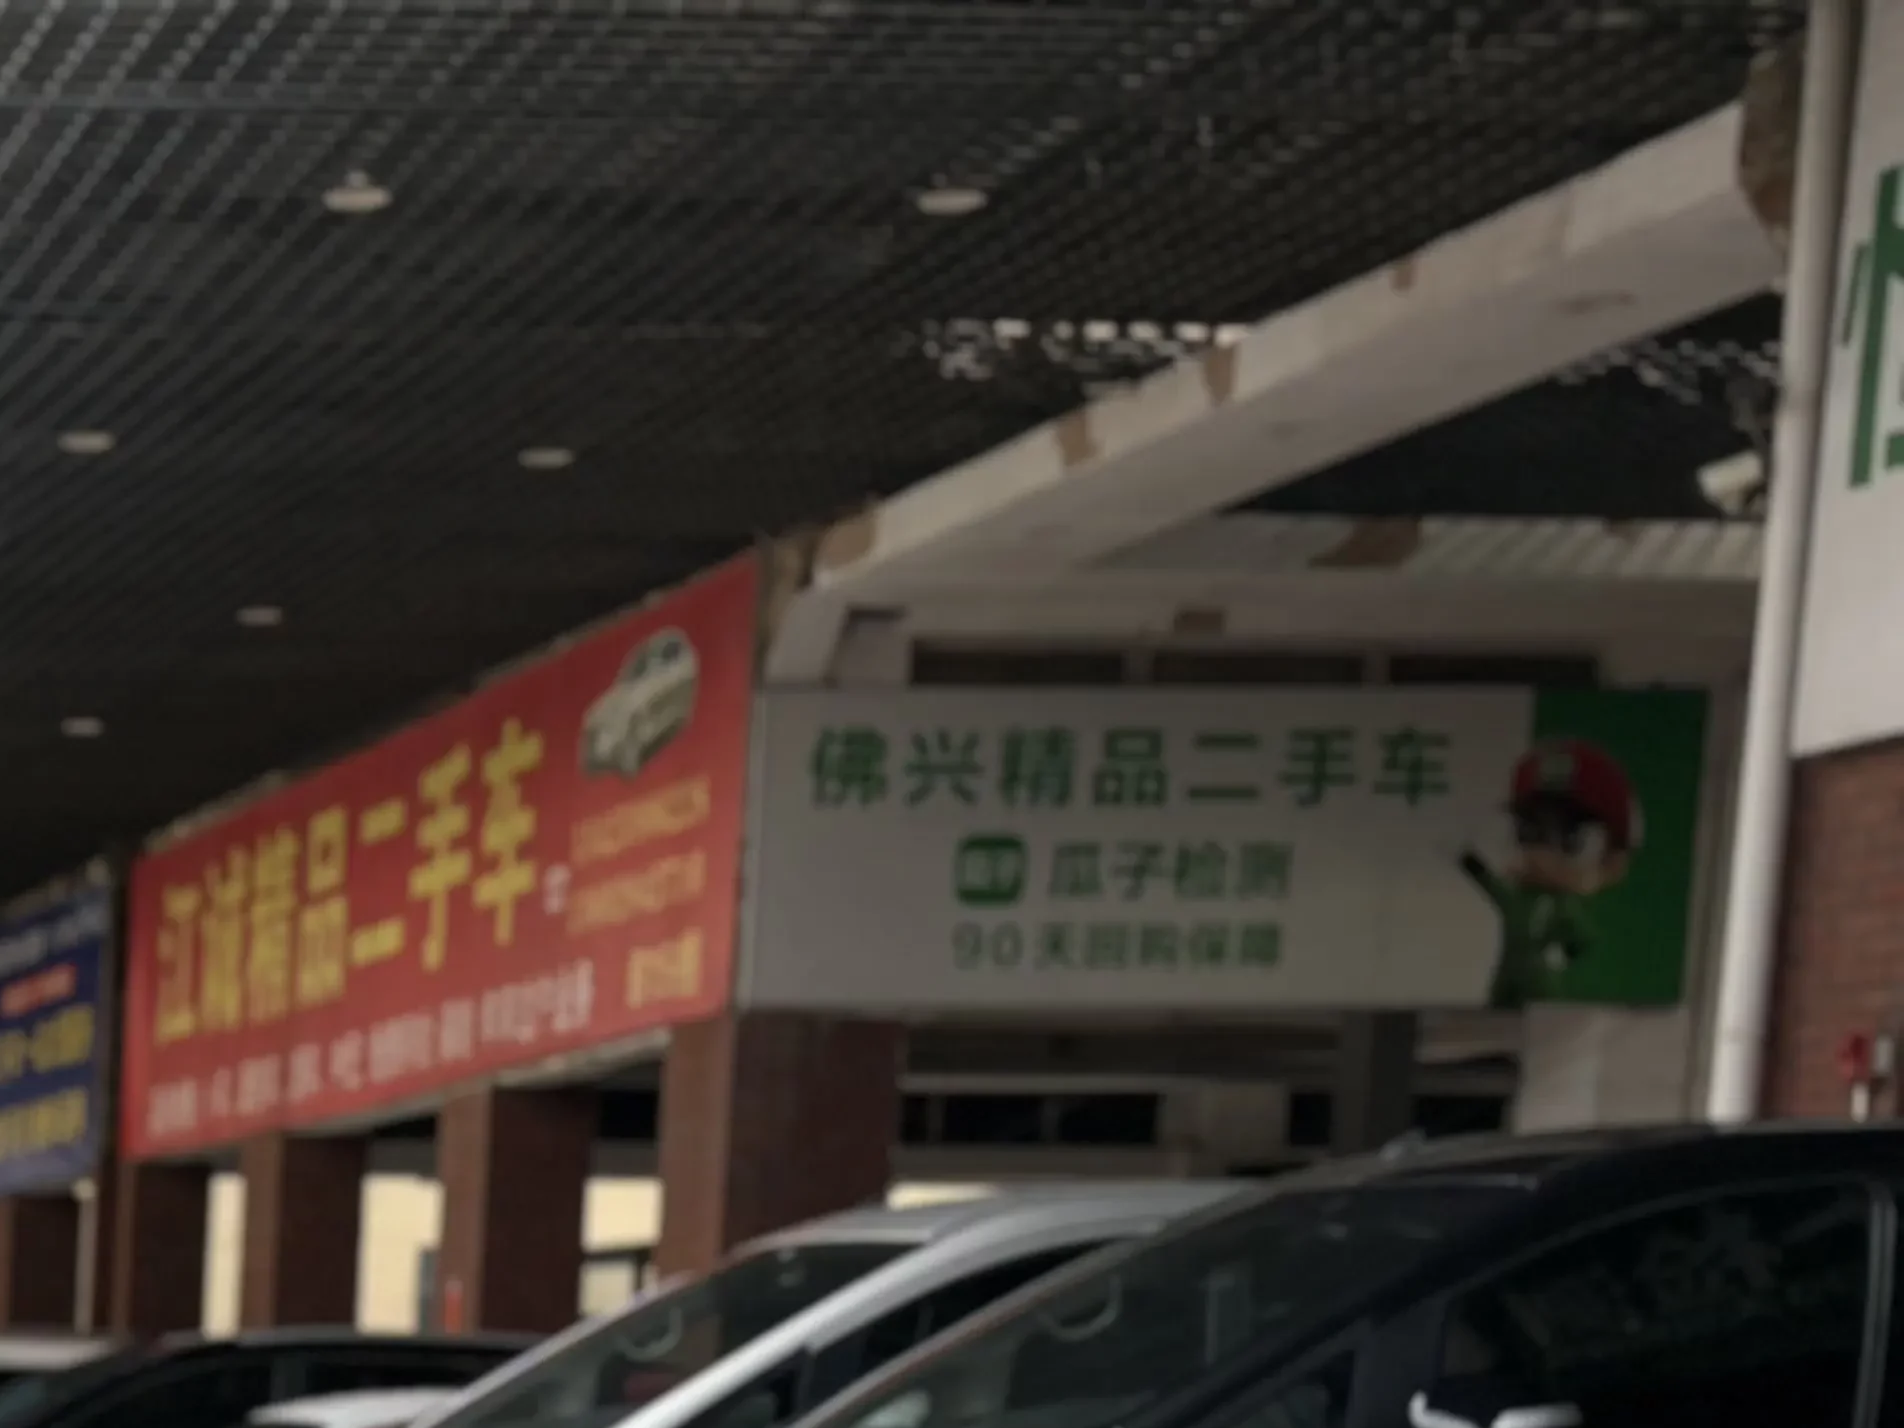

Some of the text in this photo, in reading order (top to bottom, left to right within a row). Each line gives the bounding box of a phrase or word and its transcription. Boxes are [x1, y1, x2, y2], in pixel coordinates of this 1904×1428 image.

[809, 725, 1452, 808] 佛兴精品二手车
[1048, 839, 1293, 901] 瓜子检测
